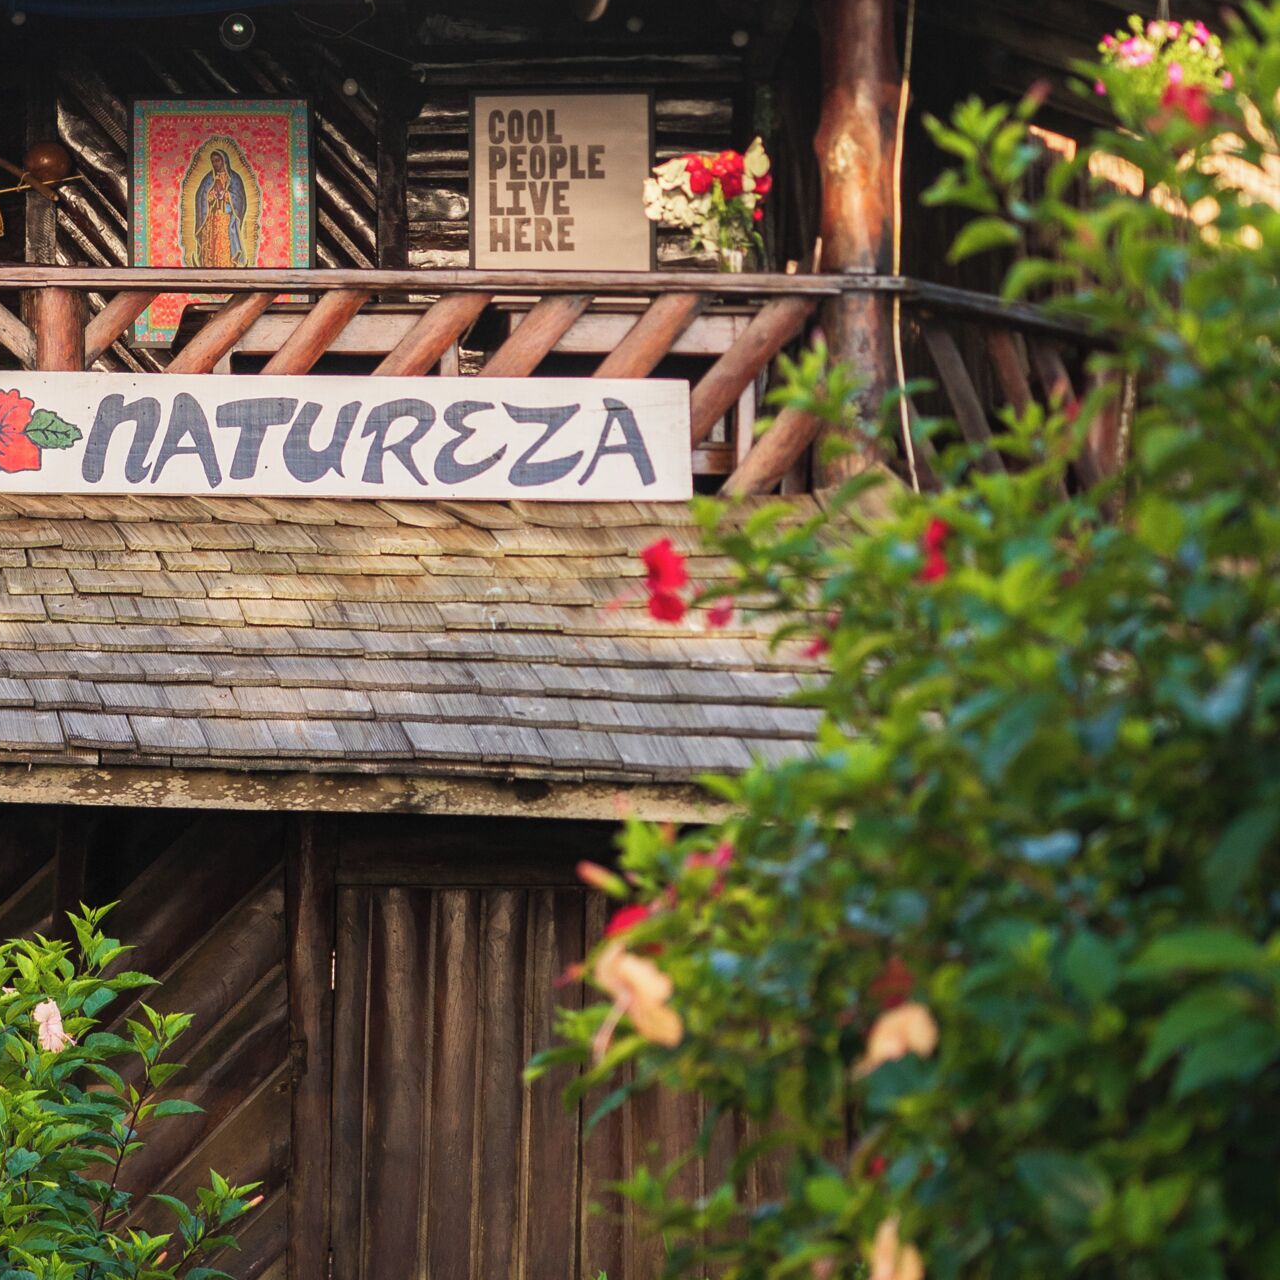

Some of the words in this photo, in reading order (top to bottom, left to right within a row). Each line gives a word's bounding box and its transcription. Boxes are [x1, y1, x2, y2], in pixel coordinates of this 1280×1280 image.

[488, 109, 563, 144] COOL
[488, 144, 605, 180] PEOPLE
[489, 181, 570, 216] LIVE
[489, 217, 575, 252] HERE
[81, 392, 657, 489] NATUREZA
